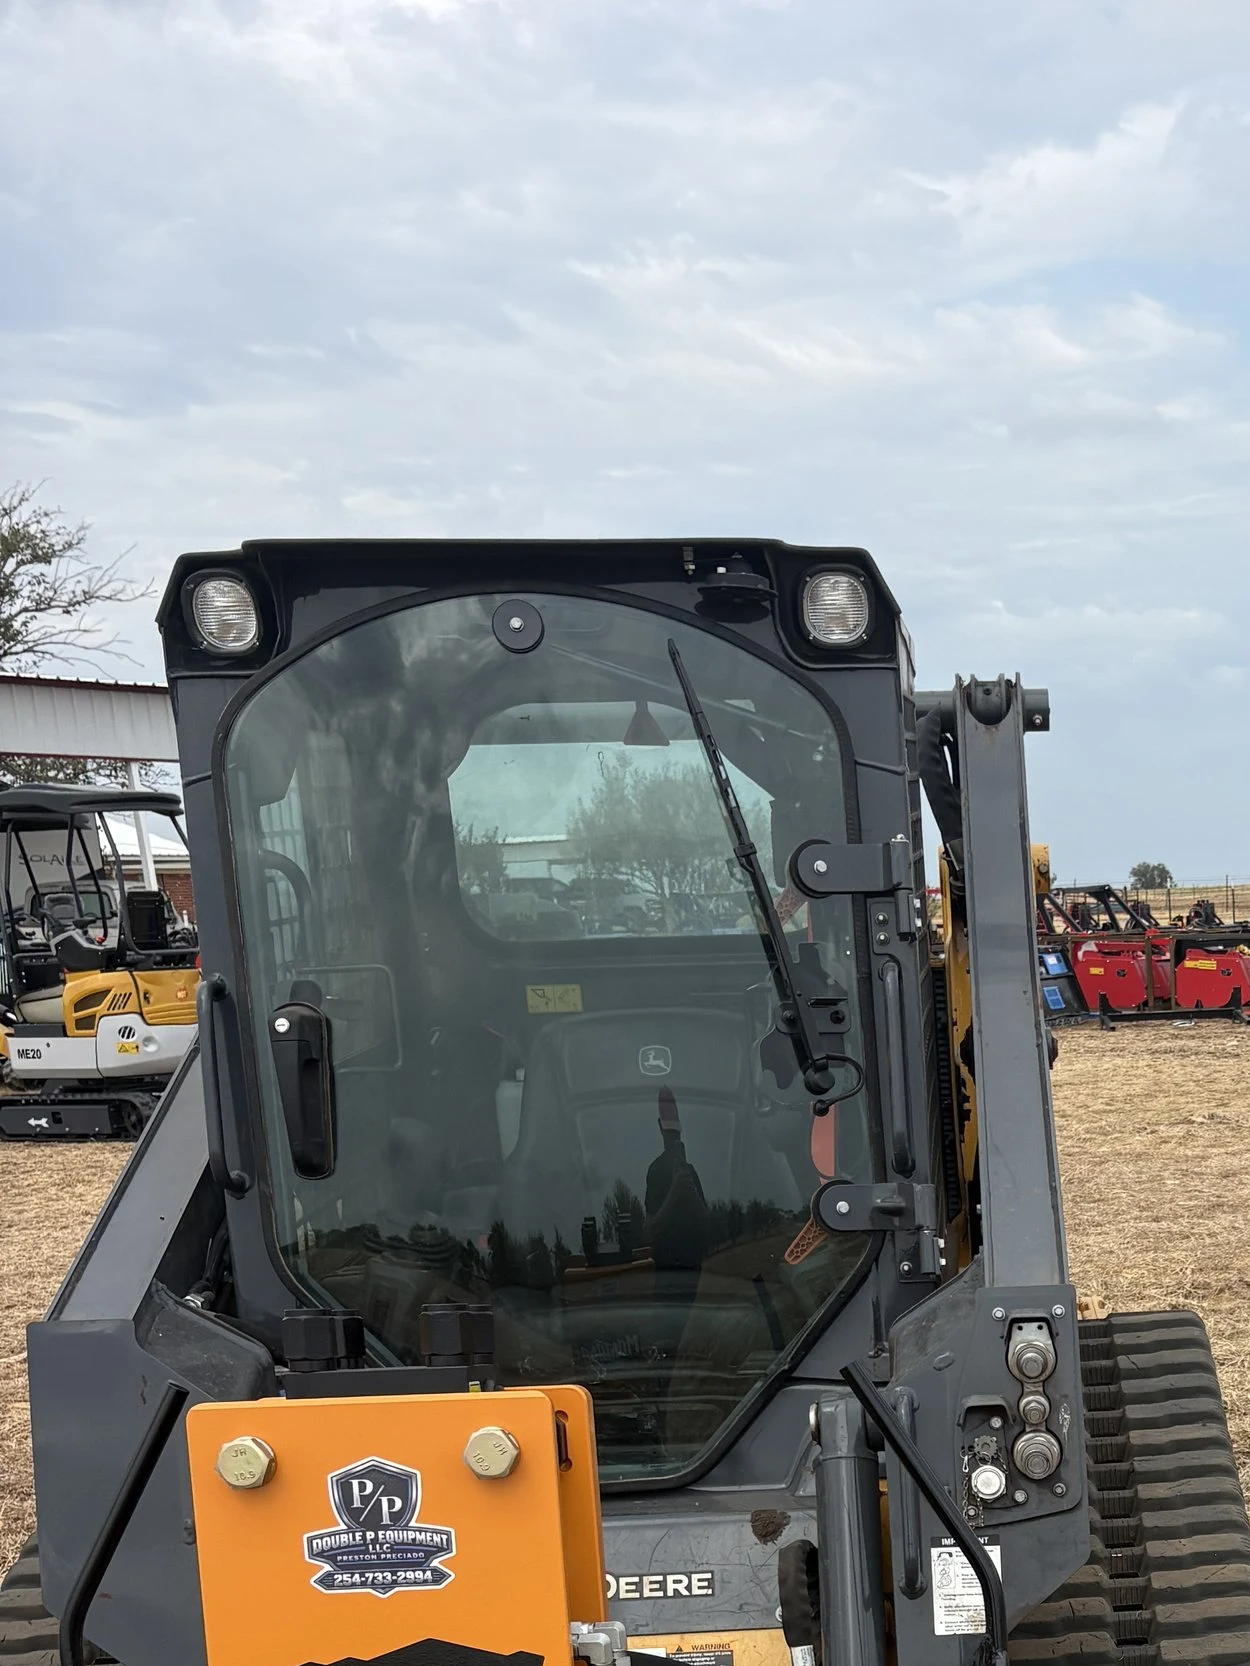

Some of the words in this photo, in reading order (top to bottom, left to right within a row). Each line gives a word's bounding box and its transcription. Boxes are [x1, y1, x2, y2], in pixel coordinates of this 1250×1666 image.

[17, 1049, 42, 1060] ME20
[312, 1531, 364, 1555] DOUBLE
[366, 1531, 376, 1544] P
[378, 1530, 448, 1549] EQUIPMENT
[369, 1544, 391, 1553] LLC
[337, 1554, 377, 1562] PRESTON
[380, 1552, 425, 1560] PRECIADO
[333, 1570, 434, 1587] 254-733-2994
[691, 1643, 731, 1651] WARNING
